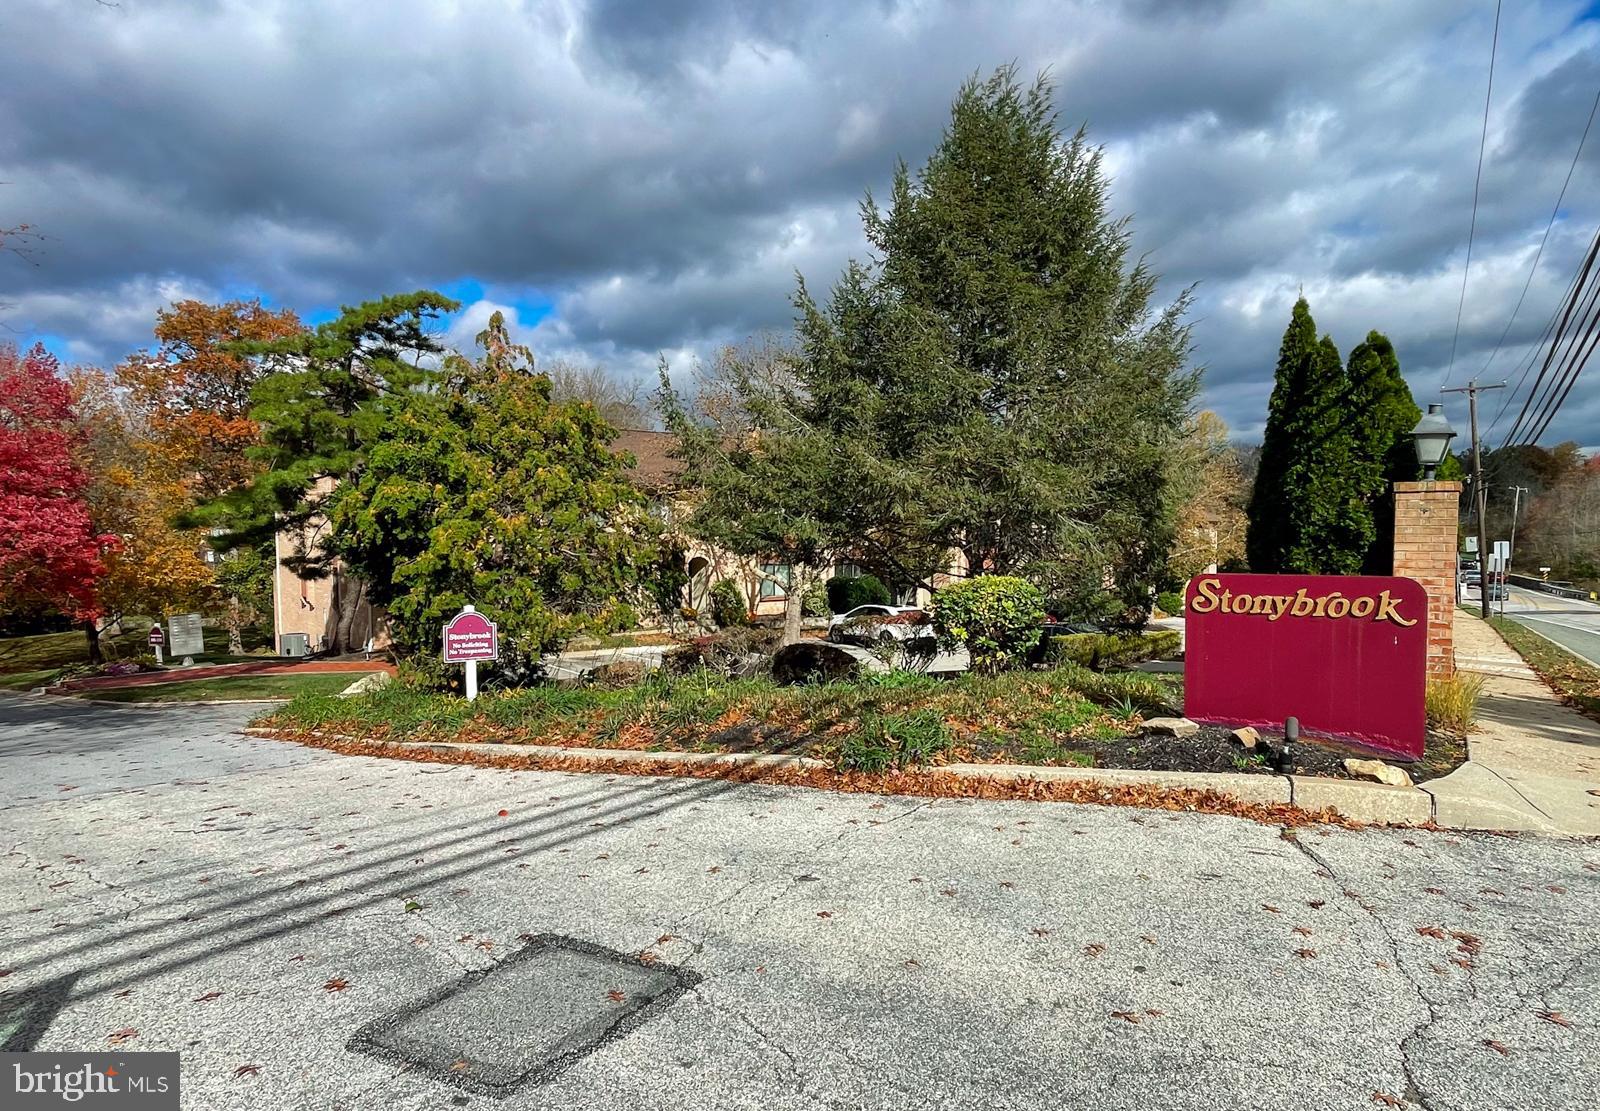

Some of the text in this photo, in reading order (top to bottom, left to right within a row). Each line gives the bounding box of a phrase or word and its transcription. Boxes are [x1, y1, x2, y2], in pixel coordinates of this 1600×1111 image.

[1191, 578, 1418, 627] Stonybrook
[449, 632, 491, 641] Stonybrook
[458, 648, 492, 656] Trespassing
